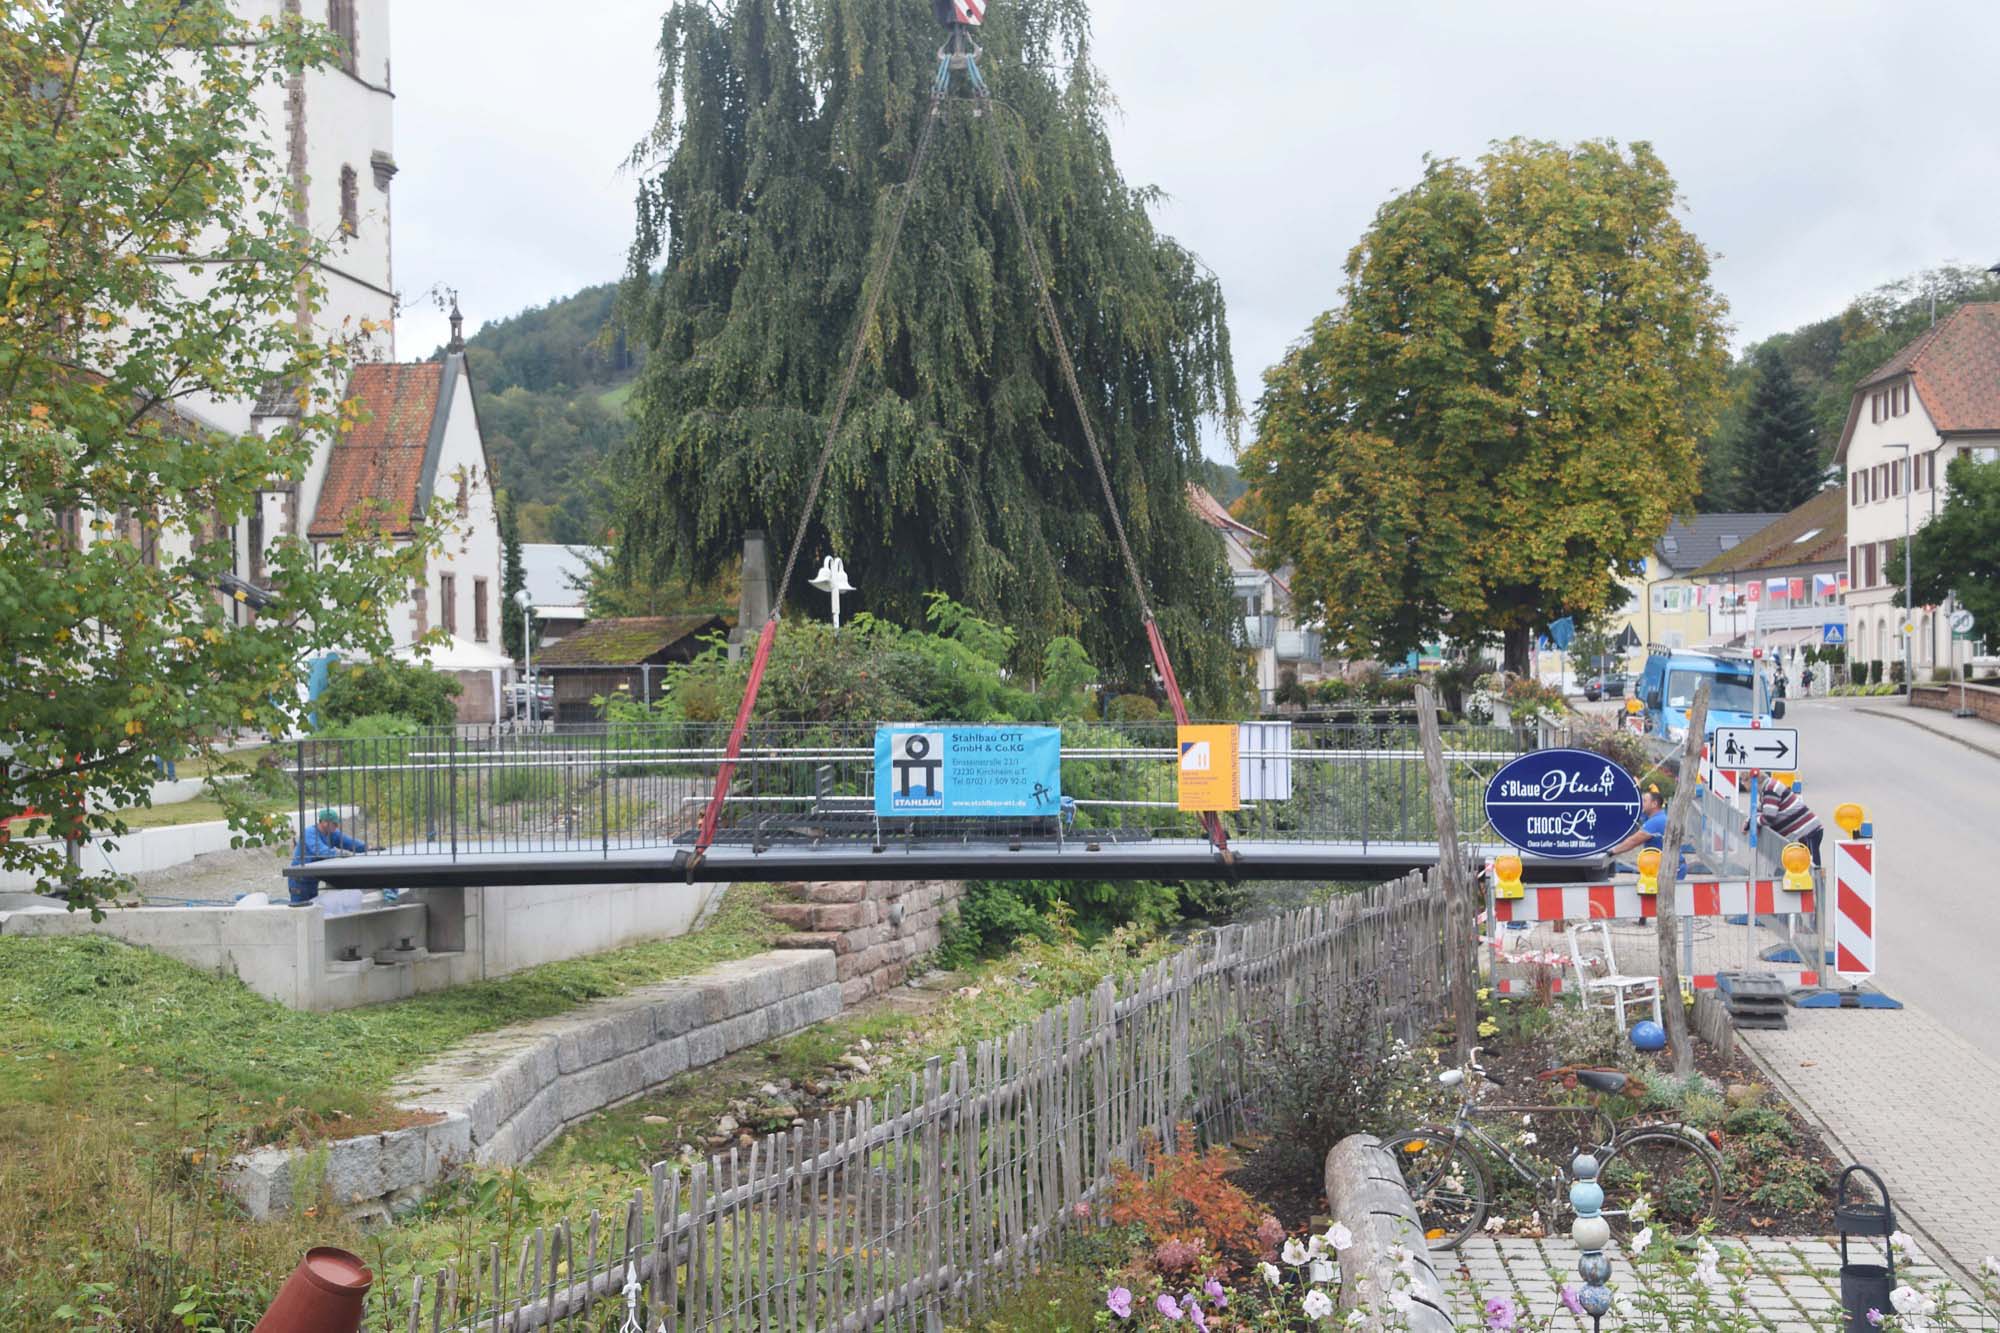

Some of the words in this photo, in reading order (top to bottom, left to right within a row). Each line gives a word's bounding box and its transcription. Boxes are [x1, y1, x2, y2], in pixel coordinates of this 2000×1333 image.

[952, 733, 997, 742] Stahlbau
[1000, 733, 1024, 742] OTT
[952, 744, 982, 752] GmbH
[985, 744, 992, 752] &
[995, 744, 1025, 752] Co.KG
[894, 799, 942, 807] STAHLBAU
